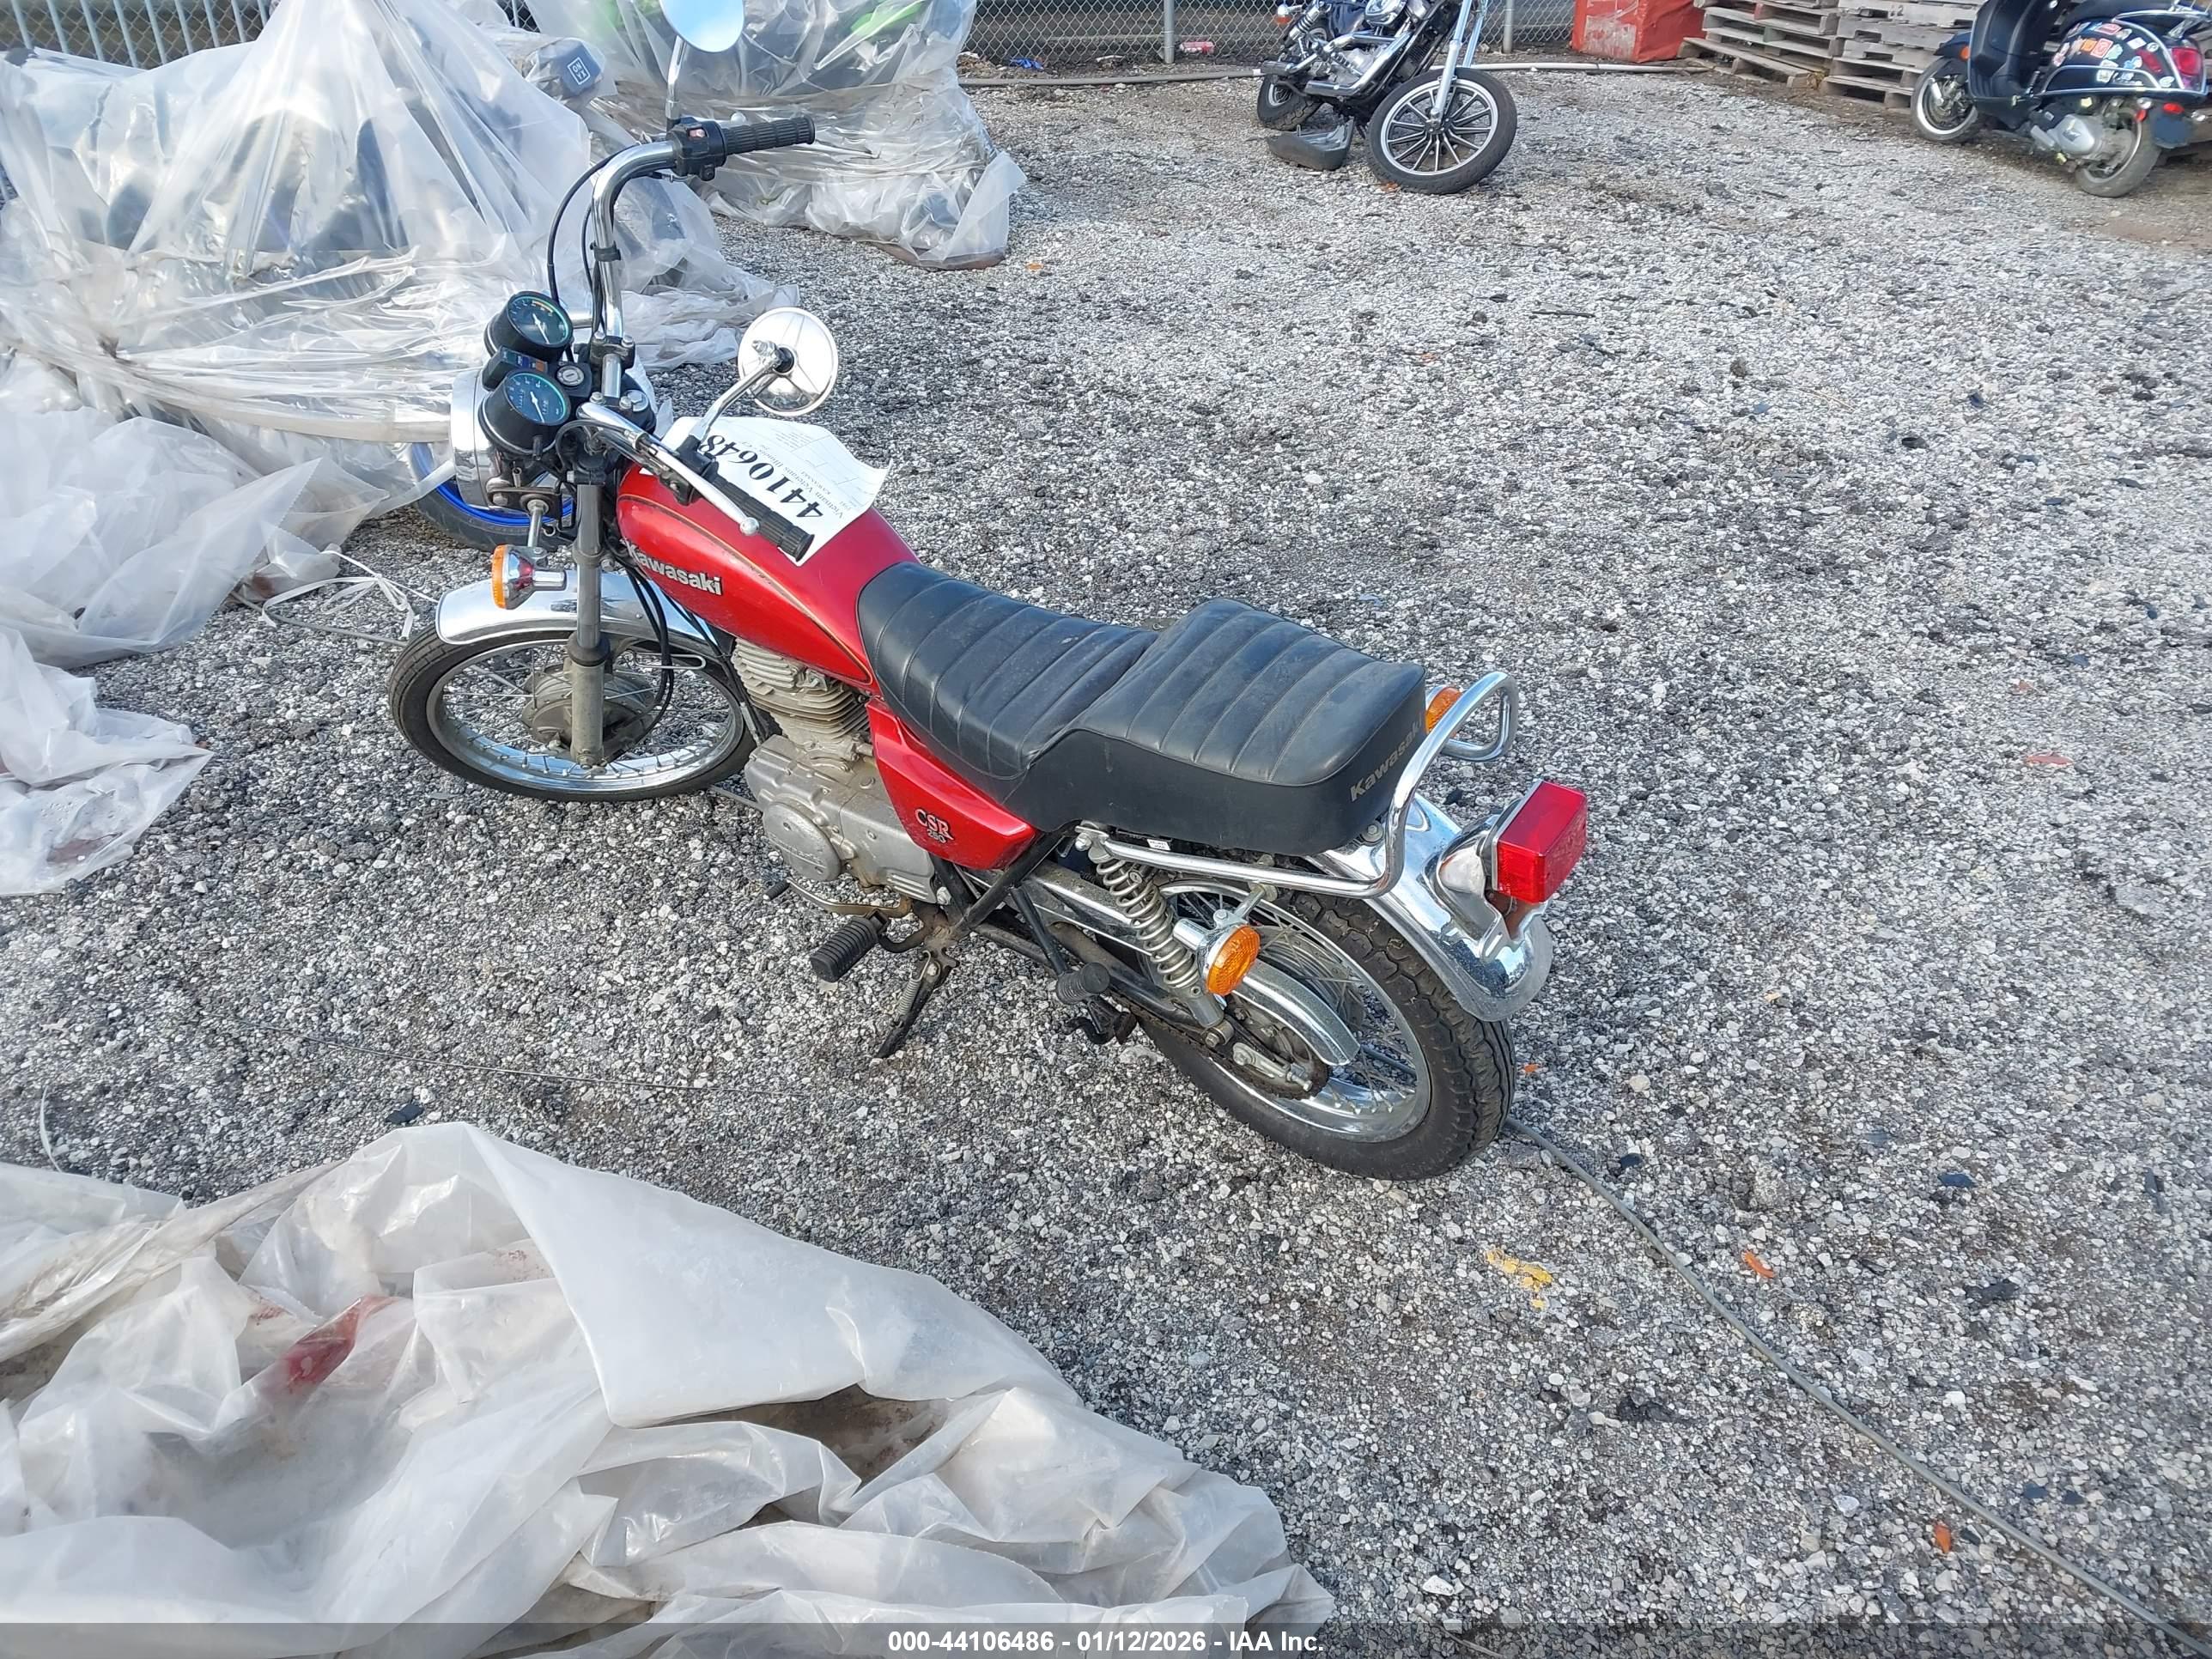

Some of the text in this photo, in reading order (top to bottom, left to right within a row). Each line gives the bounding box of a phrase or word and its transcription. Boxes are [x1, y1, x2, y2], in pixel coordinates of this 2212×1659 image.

[783, 466, 815, 495] Veterans
[815, 492, 845, 519] Vietnam
[627, 542, 723, 596] Kawasaki
[1349, 714, 1422, 803] Kawasaki
[915, 808, 954, 841] CSR
